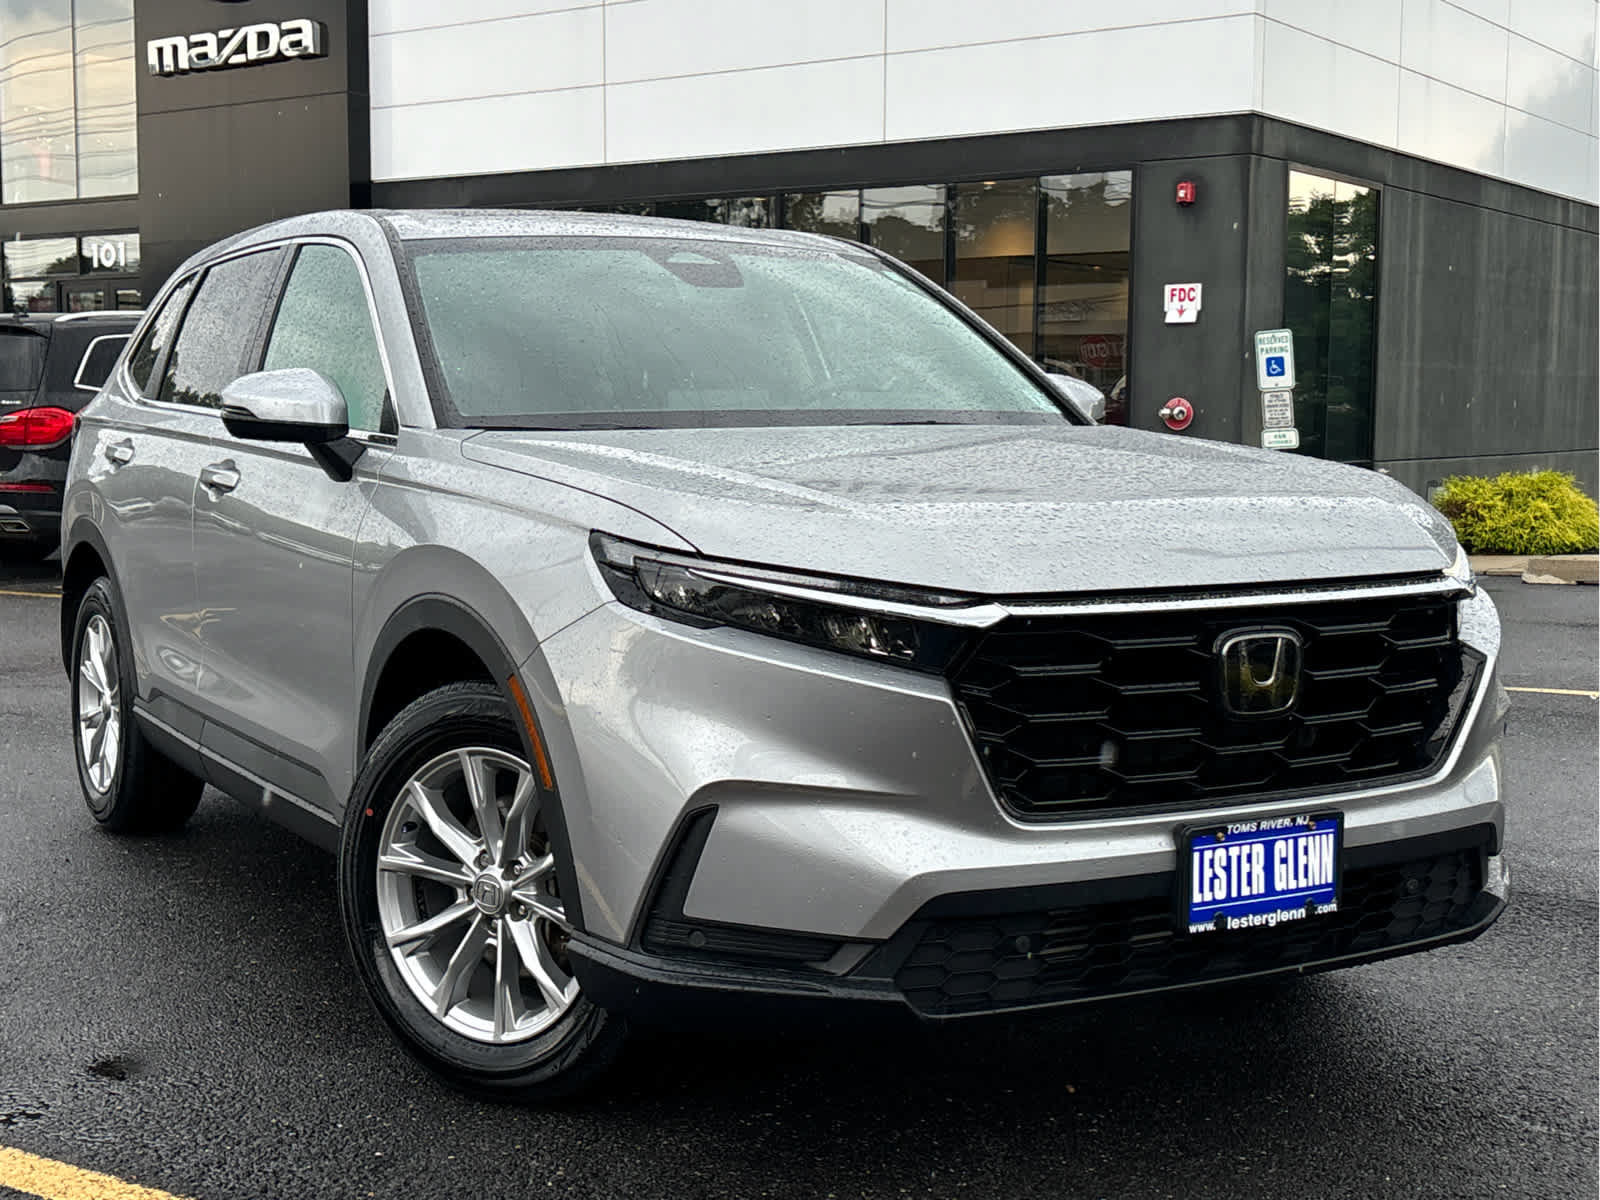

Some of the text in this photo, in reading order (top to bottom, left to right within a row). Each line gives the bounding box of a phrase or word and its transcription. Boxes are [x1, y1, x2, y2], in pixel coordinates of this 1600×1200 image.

[91, 241, 126, 269] 101
[1170, 287, 1197, 303] FDC
[1259, 345, 1290, 354] PARKING
[1226, 822, 1257, 835] TOMS
[1295, 815, 1311, 827] NJ
[1192, 833, 1334, 904] LESTER GLENN
[1189, 902, 1338, 934] www. lesterglenn .com
